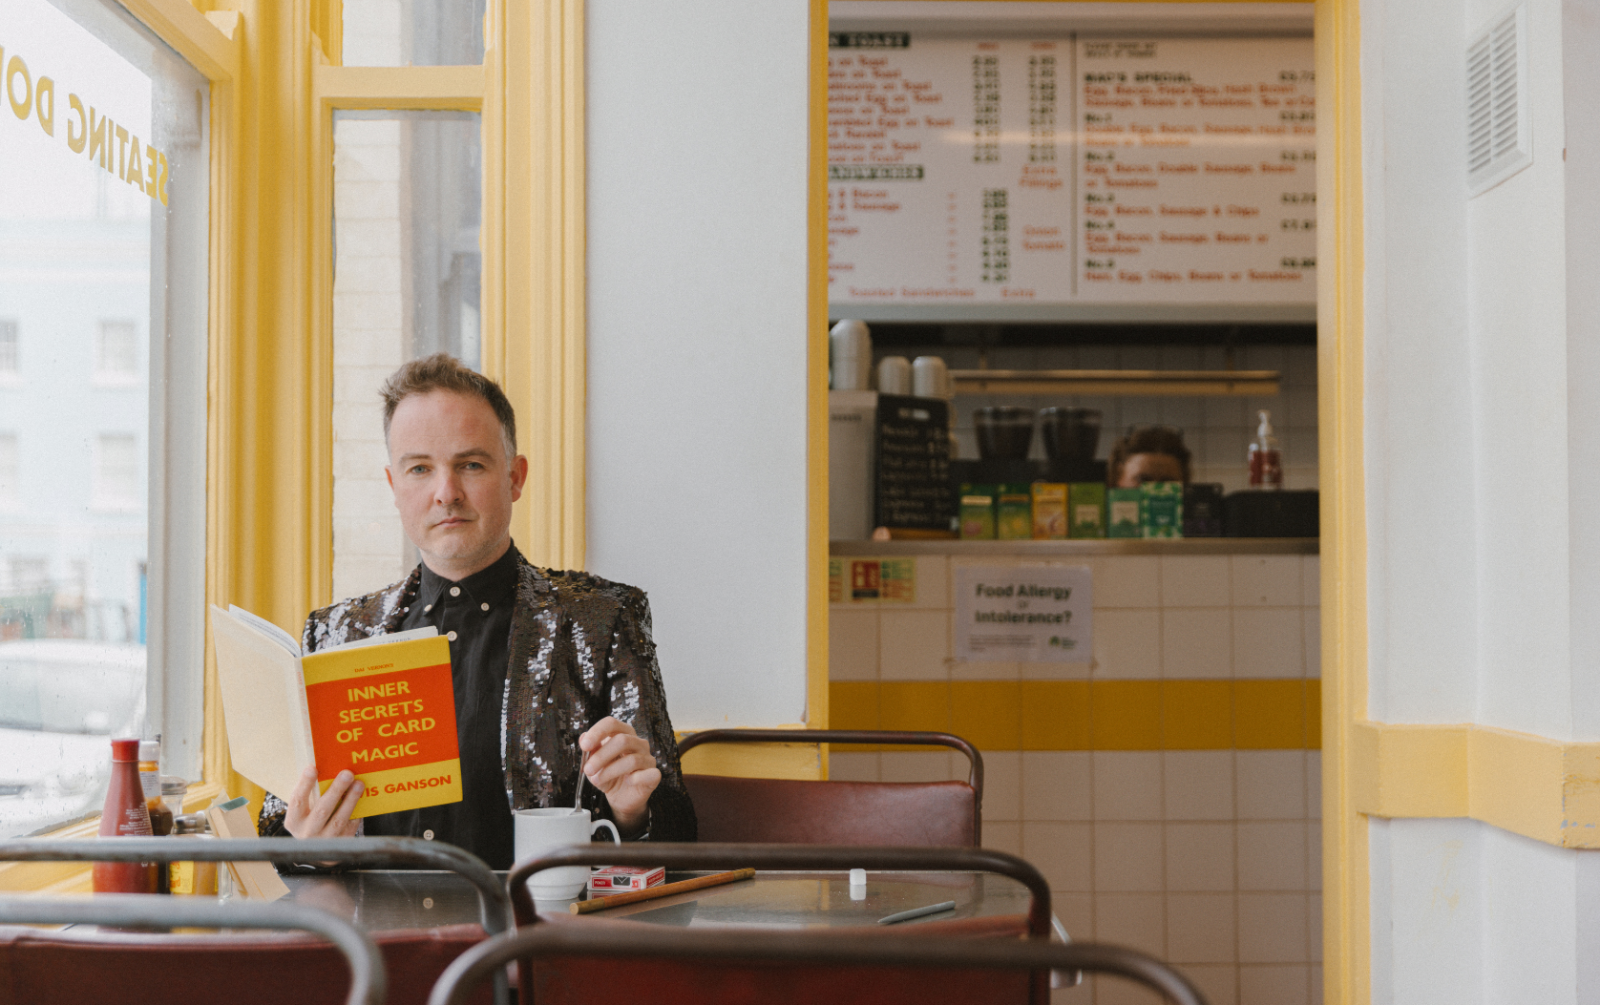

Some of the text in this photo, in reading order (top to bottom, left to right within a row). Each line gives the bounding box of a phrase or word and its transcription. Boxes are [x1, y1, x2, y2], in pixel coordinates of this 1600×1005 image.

[1133, 73, 1193, 83] SPECIAL
[1141, 97, 1176, 108] Beans
[1104, 178, 1159, 188] Tomatoes
[1226, 206, 1259, 217] Chips
[1188, 272, 1223, 282] Beans
[1248, 272, 1303, 282] Tomatoes
[976, 583, 1072, 601] Food Allergy
[975, 610, 1072, 624] Intolerance?
[347, 681, 411, 702] INNER
[339, 699, 424, 724] SECRETS
[336, 717, 436, 743] OF CARD
[351, 742, 419, 764] MAGIC
[384, 775, 452, 794] GANSON
